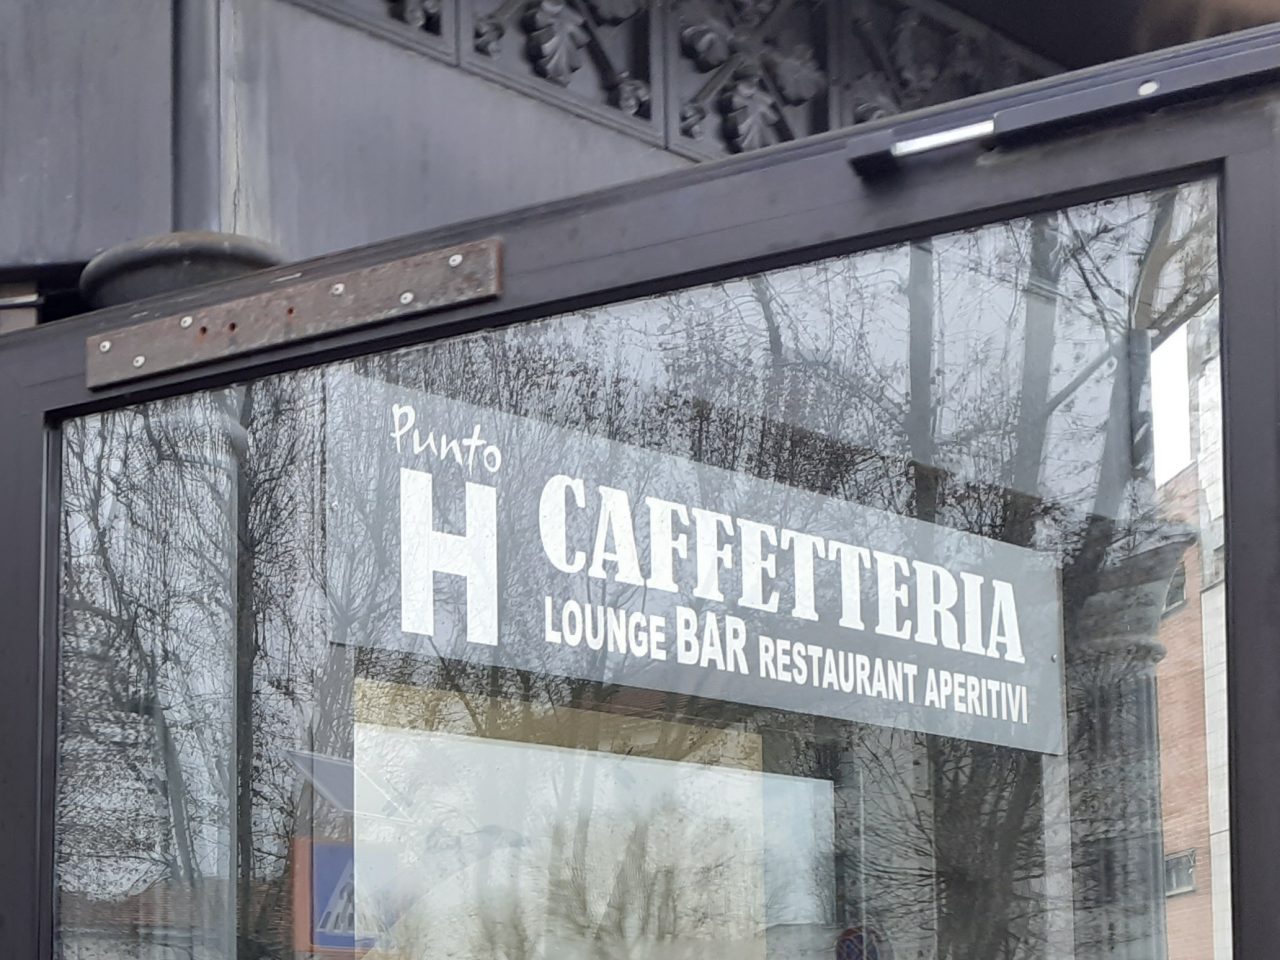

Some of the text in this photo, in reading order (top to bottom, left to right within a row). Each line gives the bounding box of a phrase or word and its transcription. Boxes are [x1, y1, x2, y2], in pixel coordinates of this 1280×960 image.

[390, 402, 502, 474] Punto
[400, 467, 498, 646] H
[538, 473, 1026, 664] CAFFETTERIA
[544, 596, 1029, 725] LOUNGE BAR RESTAURANT APERITIVI
